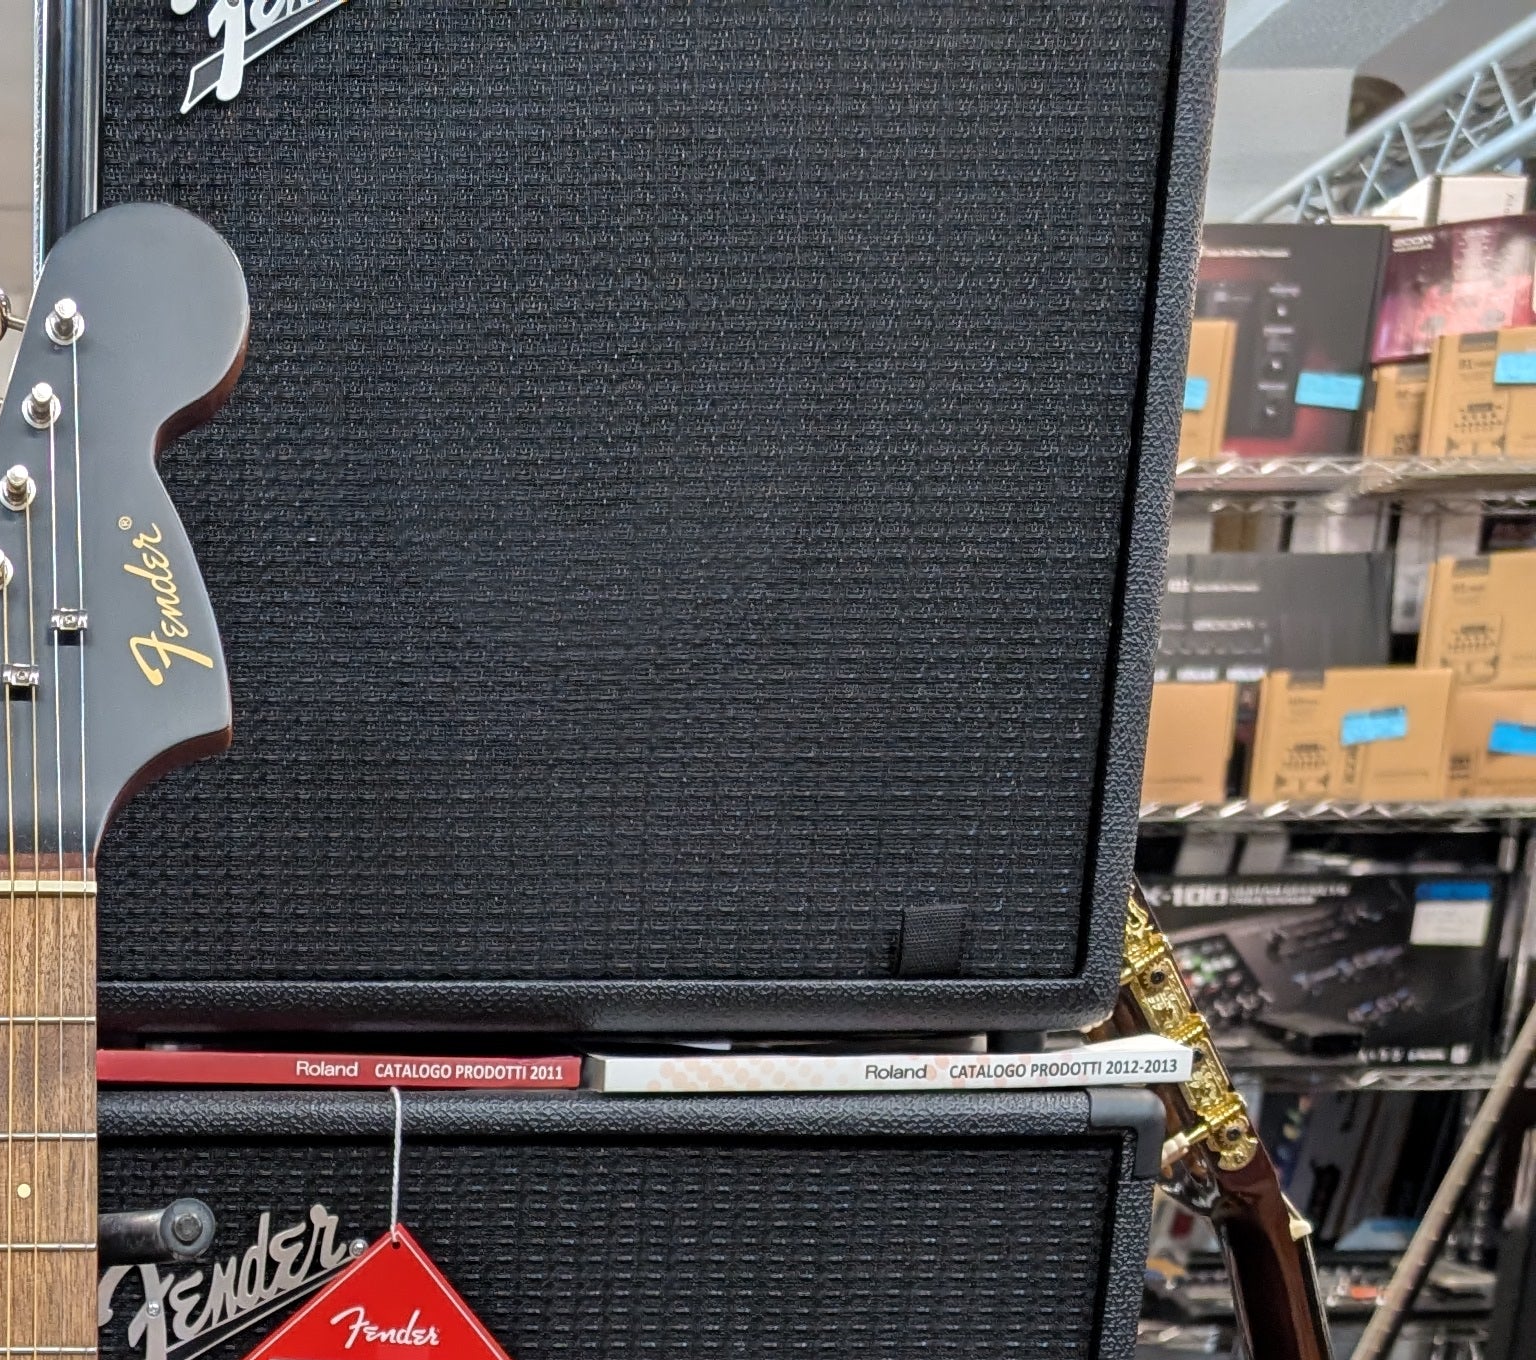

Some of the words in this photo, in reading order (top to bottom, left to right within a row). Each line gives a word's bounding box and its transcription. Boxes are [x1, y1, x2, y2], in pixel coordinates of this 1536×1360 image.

[129, 522, 214, 686] Fender
[296, 1061, 358, 1077] Roland
[375, 1064, 451, 1080] CATALOGO
[455, 1065, 526, 1080] PRODOTTI
[530, 1066, 563, 1080] 2011
[865, 1064, 927, 1079] Roland
[949, 1064, 1026, 1079] CATALOGO
[1031, 1061, 1102, 1078] PRODOTTI
[1106, 1059, 1178, 1075] 2012-2013
[330, 1306, 440, 1349] Fender
